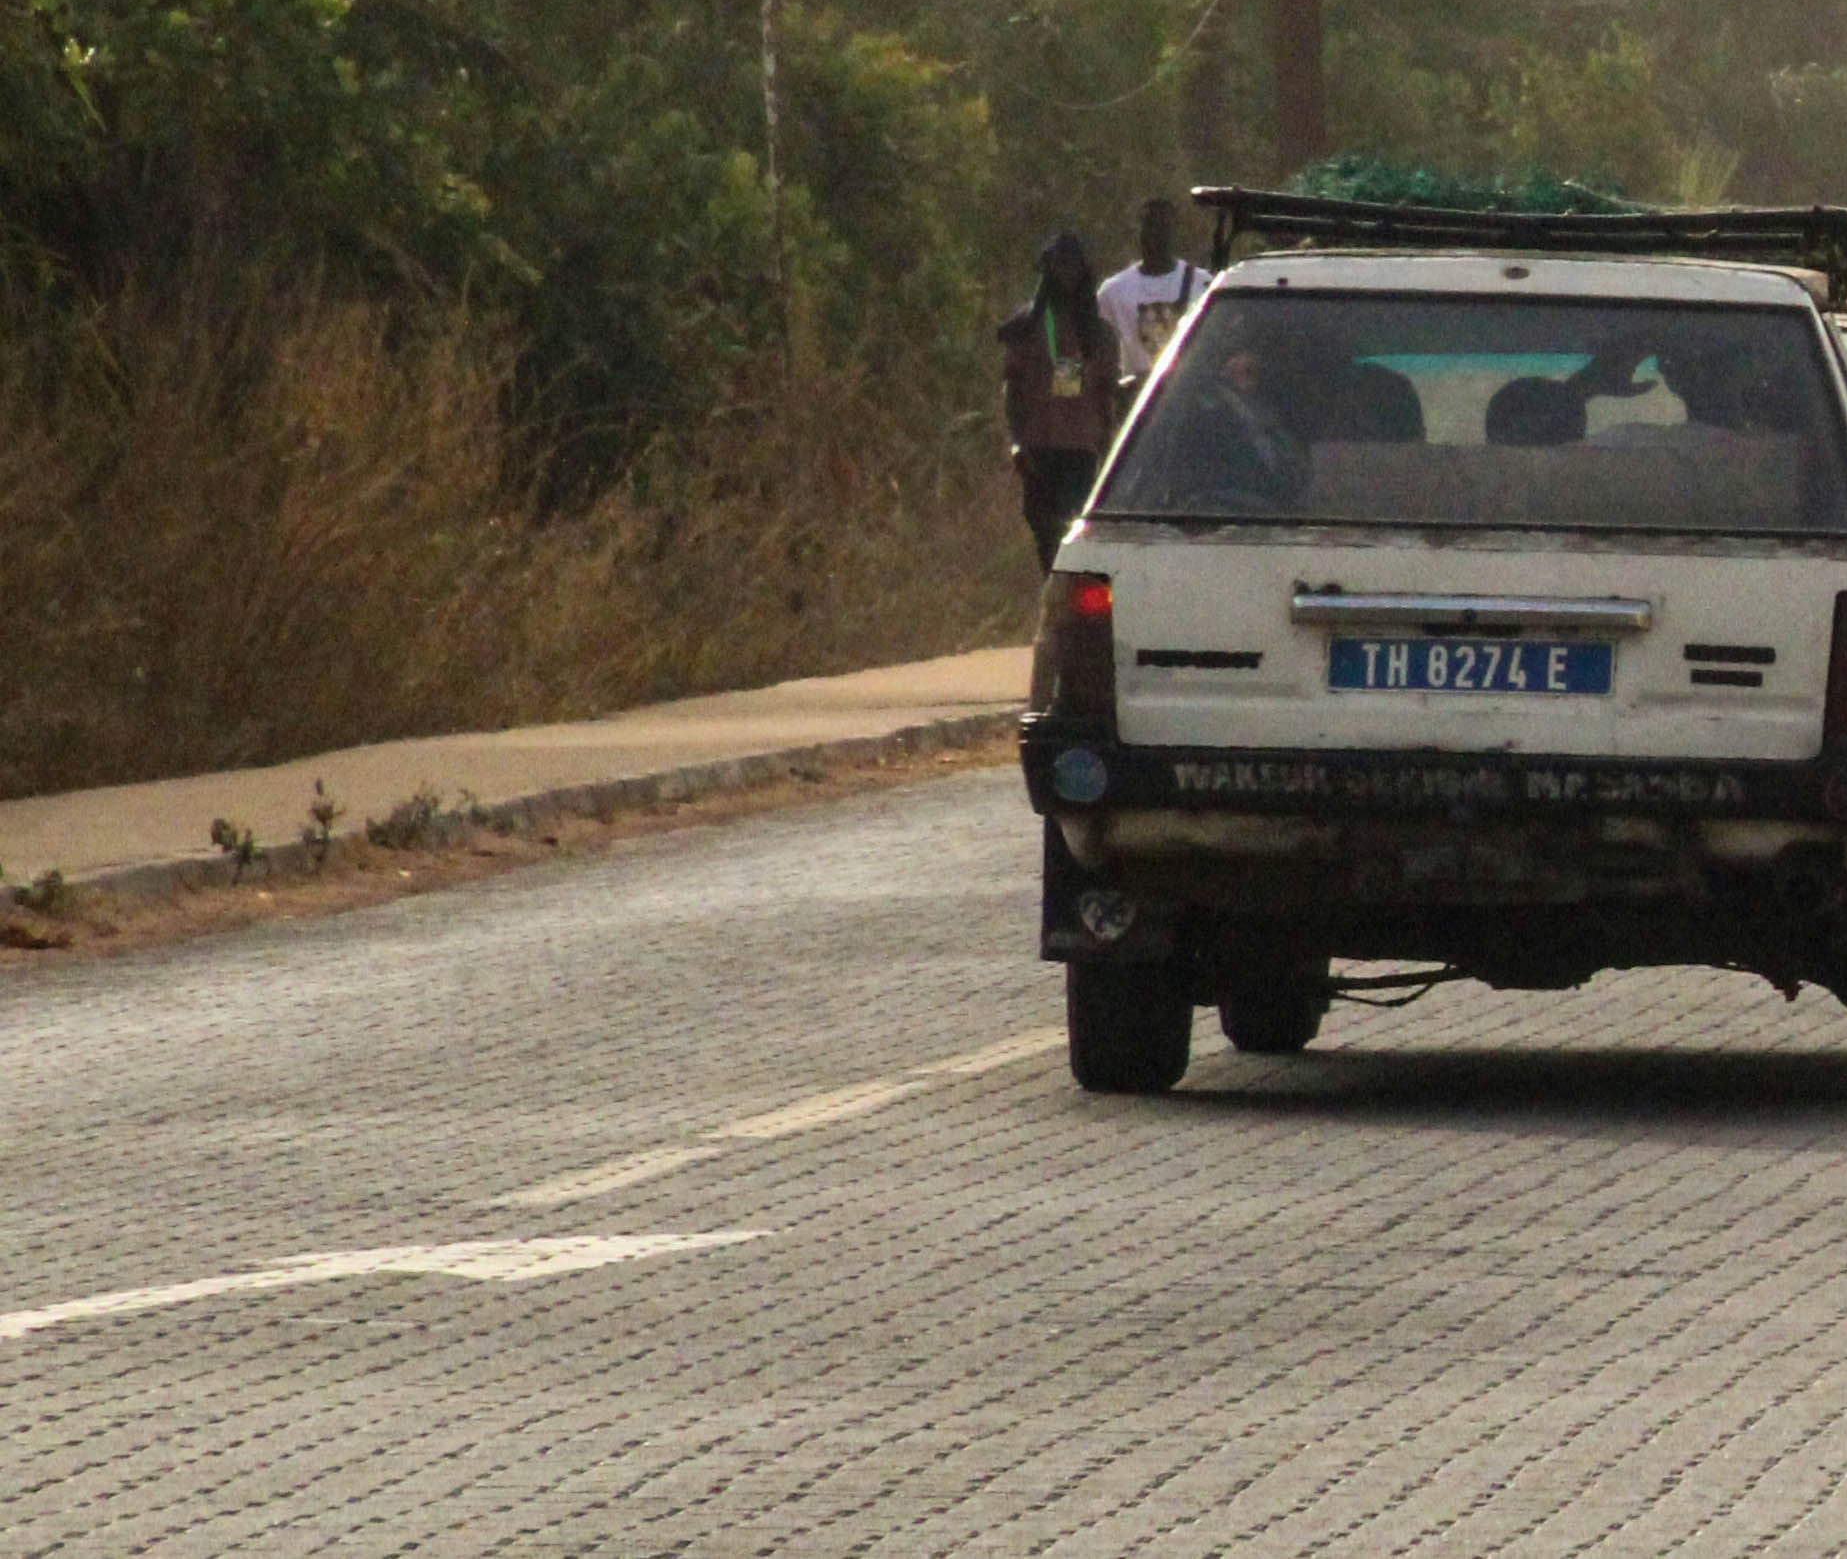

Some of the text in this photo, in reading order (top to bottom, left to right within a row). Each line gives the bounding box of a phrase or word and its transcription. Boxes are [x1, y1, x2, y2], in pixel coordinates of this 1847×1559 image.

[1363, 643, 1568, 690] TH 8274 E
